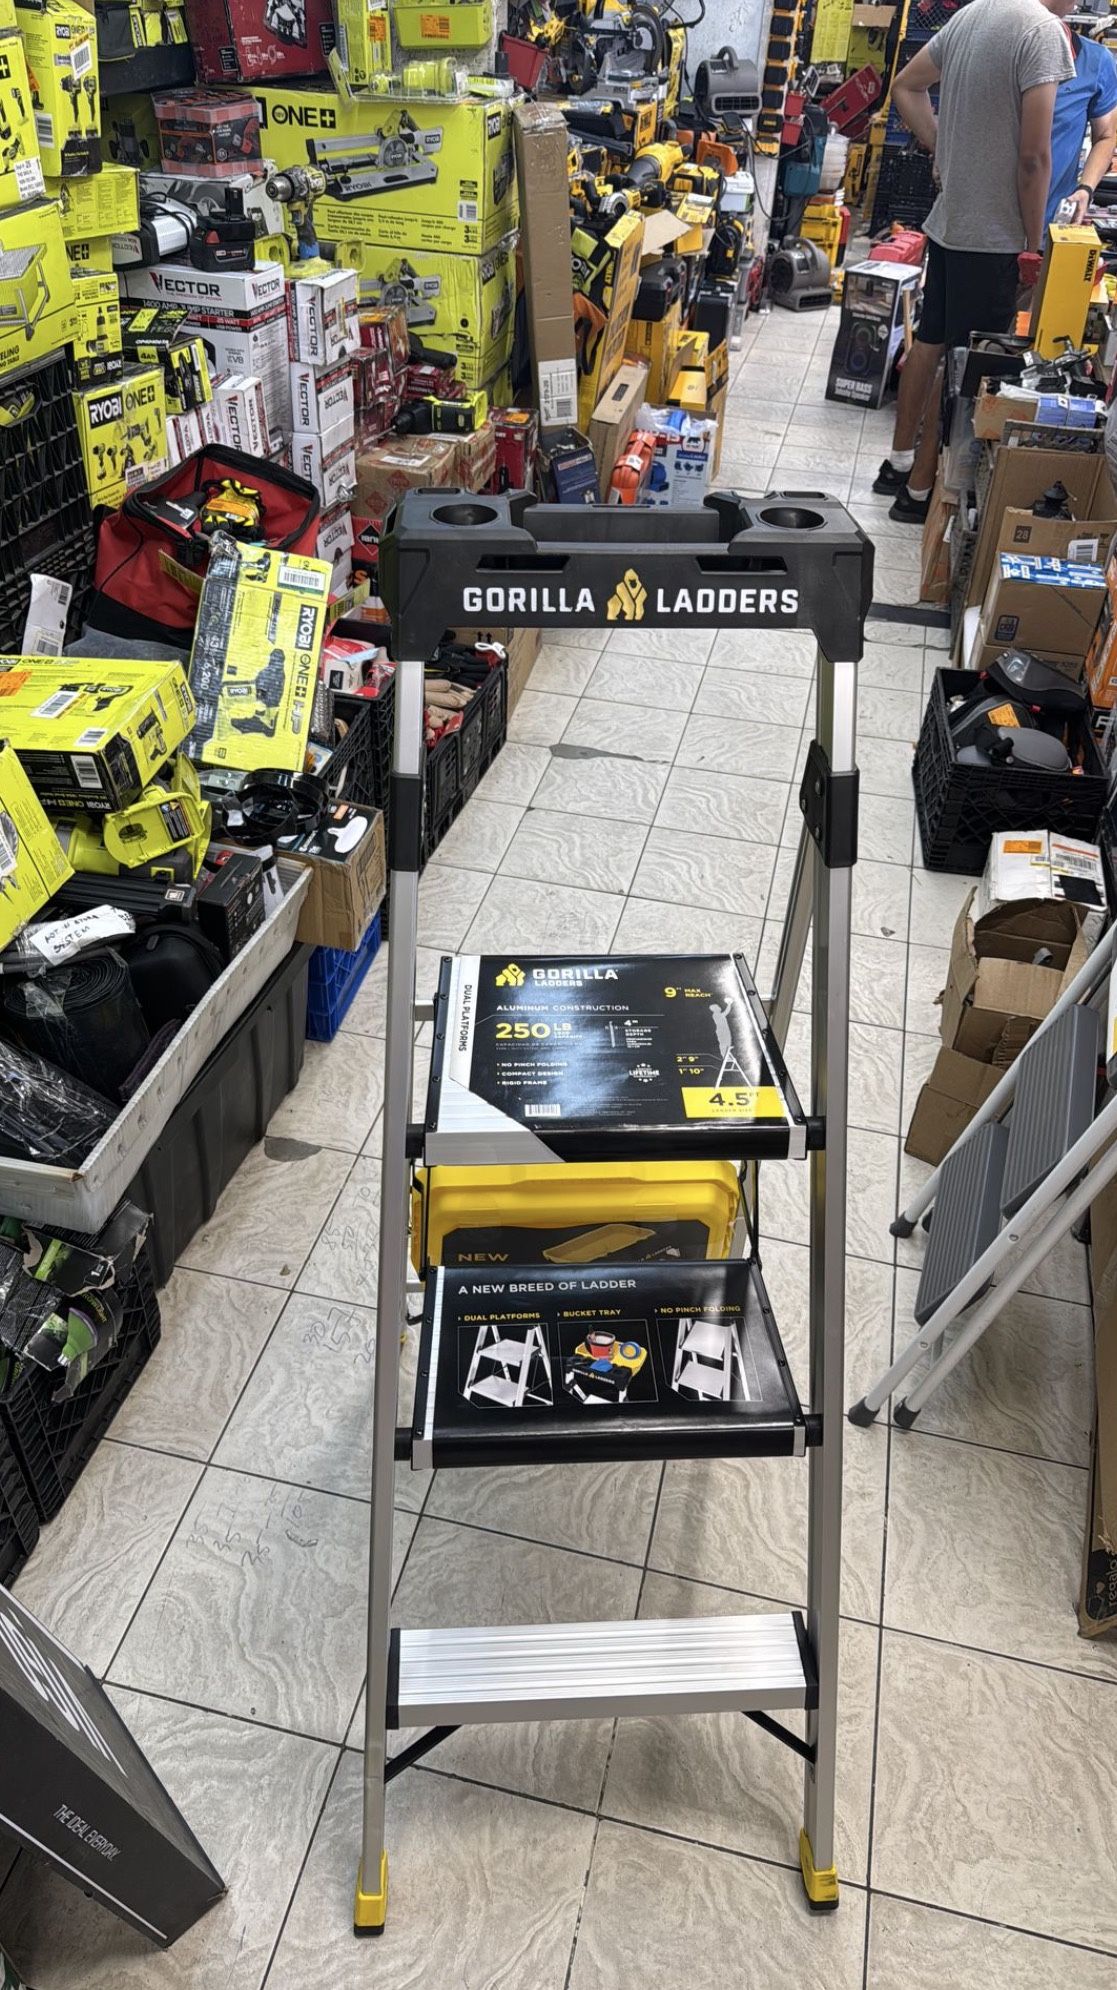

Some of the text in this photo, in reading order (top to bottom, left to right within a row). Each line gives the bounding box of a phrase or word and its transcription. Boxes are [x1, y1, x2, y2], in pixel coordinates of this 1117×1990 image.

[272, 104, 336, 129] ONE+
[66, 243, 90, 262] NE+
[1083, 249, 1097, 282] DEWALT
[150, 271, 221, 298] VECTOR
[252, 278, 280, 300] VECTOR
[202, 306, 234, 317] STARTER
[306, 296, 319, 357] VECTOR
[0, 345, 20, 358] ELING
[89, 385, 155, 425] RYOBI ONE+
[297, 373, 310, 427] VECTOR
[301, 444, 313, 482] VECT
[1015, 530, 1030, 541] 28
[463, 587, 799, 613] GORILLA LADDERS
[298, 606, 316, 650] RYOBI
[295, 654, 313, 699] ONE+
[533, 969, 618, 980] GORILLA
[459, 985, 472, 1051] DUAL PLATFORMS
[496, 1022, 572, 1038] 250 LB
[709, 1092, 750, 1106] 4.5
[458, 1253, 508, 1262] NEW
[458, 1279, 637, 1295] A NEW BREED OF LADDER
[464, 1312, 541, 1322] DUAL PLATFORMS
[563, 1309, 597, 1317] BUCKET
[675, 1306, 702, 1314] PINCH
[702, 1305, 741, 1313] FOLDING
[54, 1804, 69, 1824] THE
[68, 1814, 90, 1840] IDEAL
